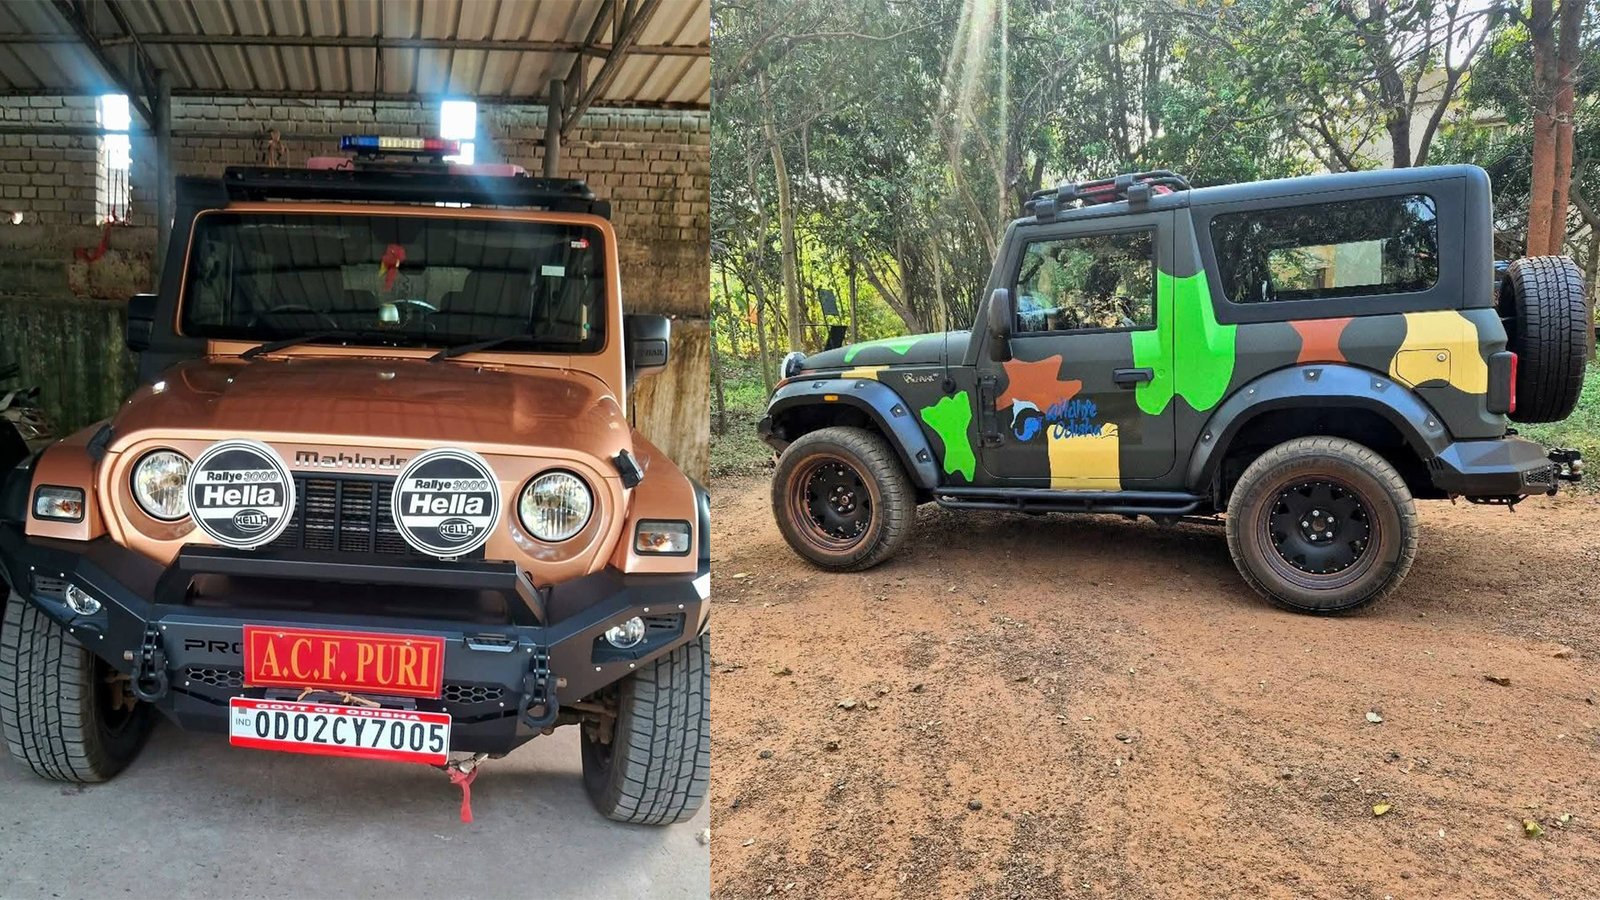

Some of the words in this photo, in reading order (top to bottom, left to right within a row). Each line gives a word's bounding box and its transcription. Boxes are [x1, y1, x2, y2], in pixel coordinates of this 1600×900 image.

[295, 450, 408, 469] Mahindr
[206, 471, 243, 482] Rallye
[243, 471, 279, 482] 3000
[414, 479, 451, 491] Rallye
[452, 480, 489, 490] 3000
[203, 485, 276, 506] Hella
[408, 493, 484, 514] Hella
[234, 514, 269, 527] HELLA
[439, 523, 476, 536] HELLA
[259, 636, 347, 682] A.C.F.
[355, 642, 432, 687] PURI
[255, 703, 309, 713] GOVT
[314, 706, 340, 714] OF
[346, 709, 421, 720] ODISHA
[235, 718, 252, 727] IND
